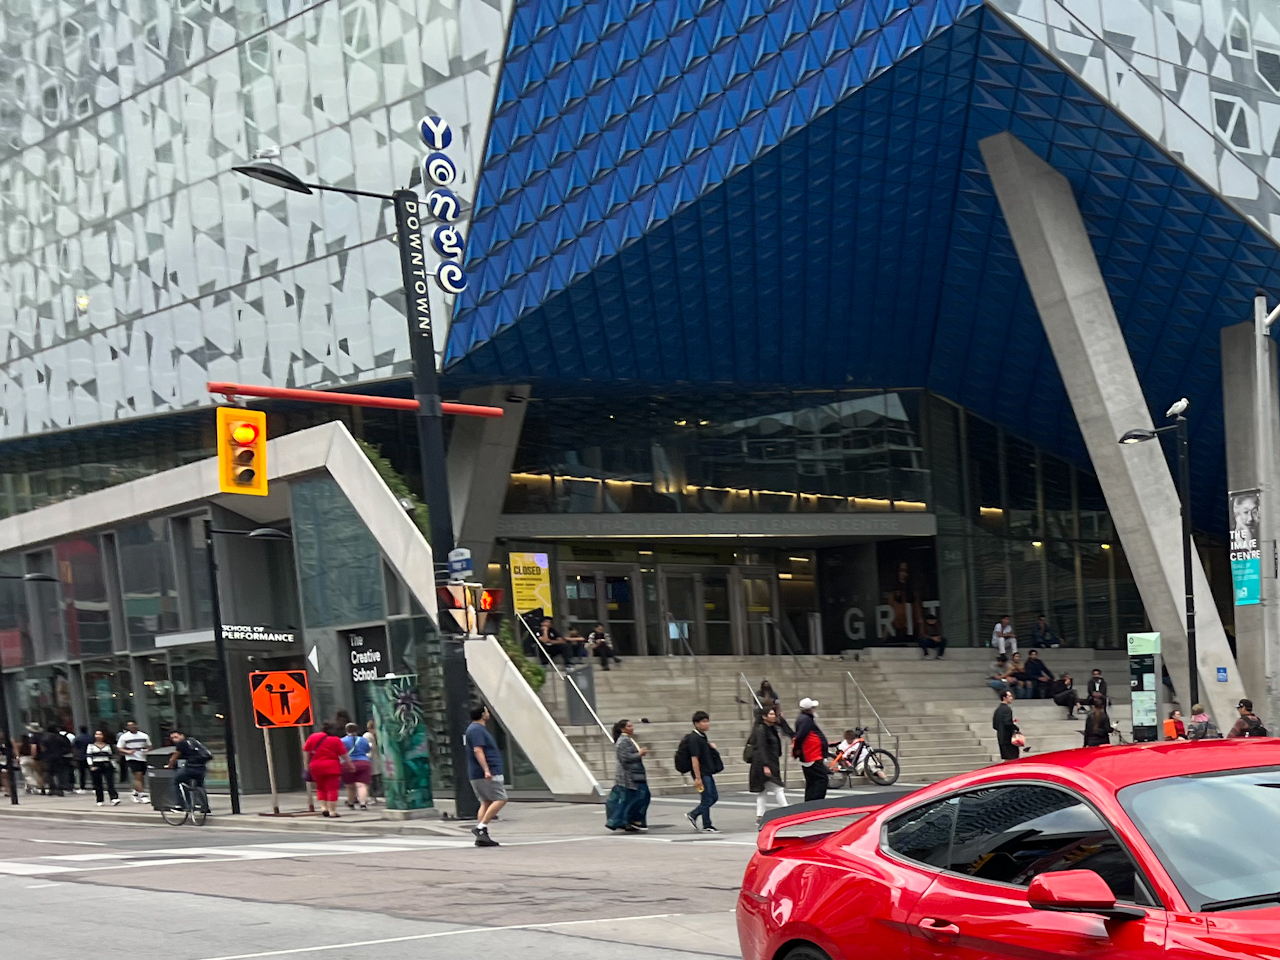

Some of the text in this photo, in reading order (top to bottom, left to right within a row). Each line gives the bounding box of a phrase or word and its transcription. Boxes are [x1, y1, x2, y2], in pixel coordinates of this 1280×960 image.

[422, 115, 469, 293] Yonge
[1229, 530, 1247, 540] THE
[513, 565, 541, 575] CLOSED
[843, 600, 940, 641] GRIT
[222, 624, 253, 633] SCHOOL
[222, 631, 294, 643] PERFORMANCE
[351, 634, 364, 647] The
[351, 649, 381, 665] Creative
[352, 666, 378, 682] School
